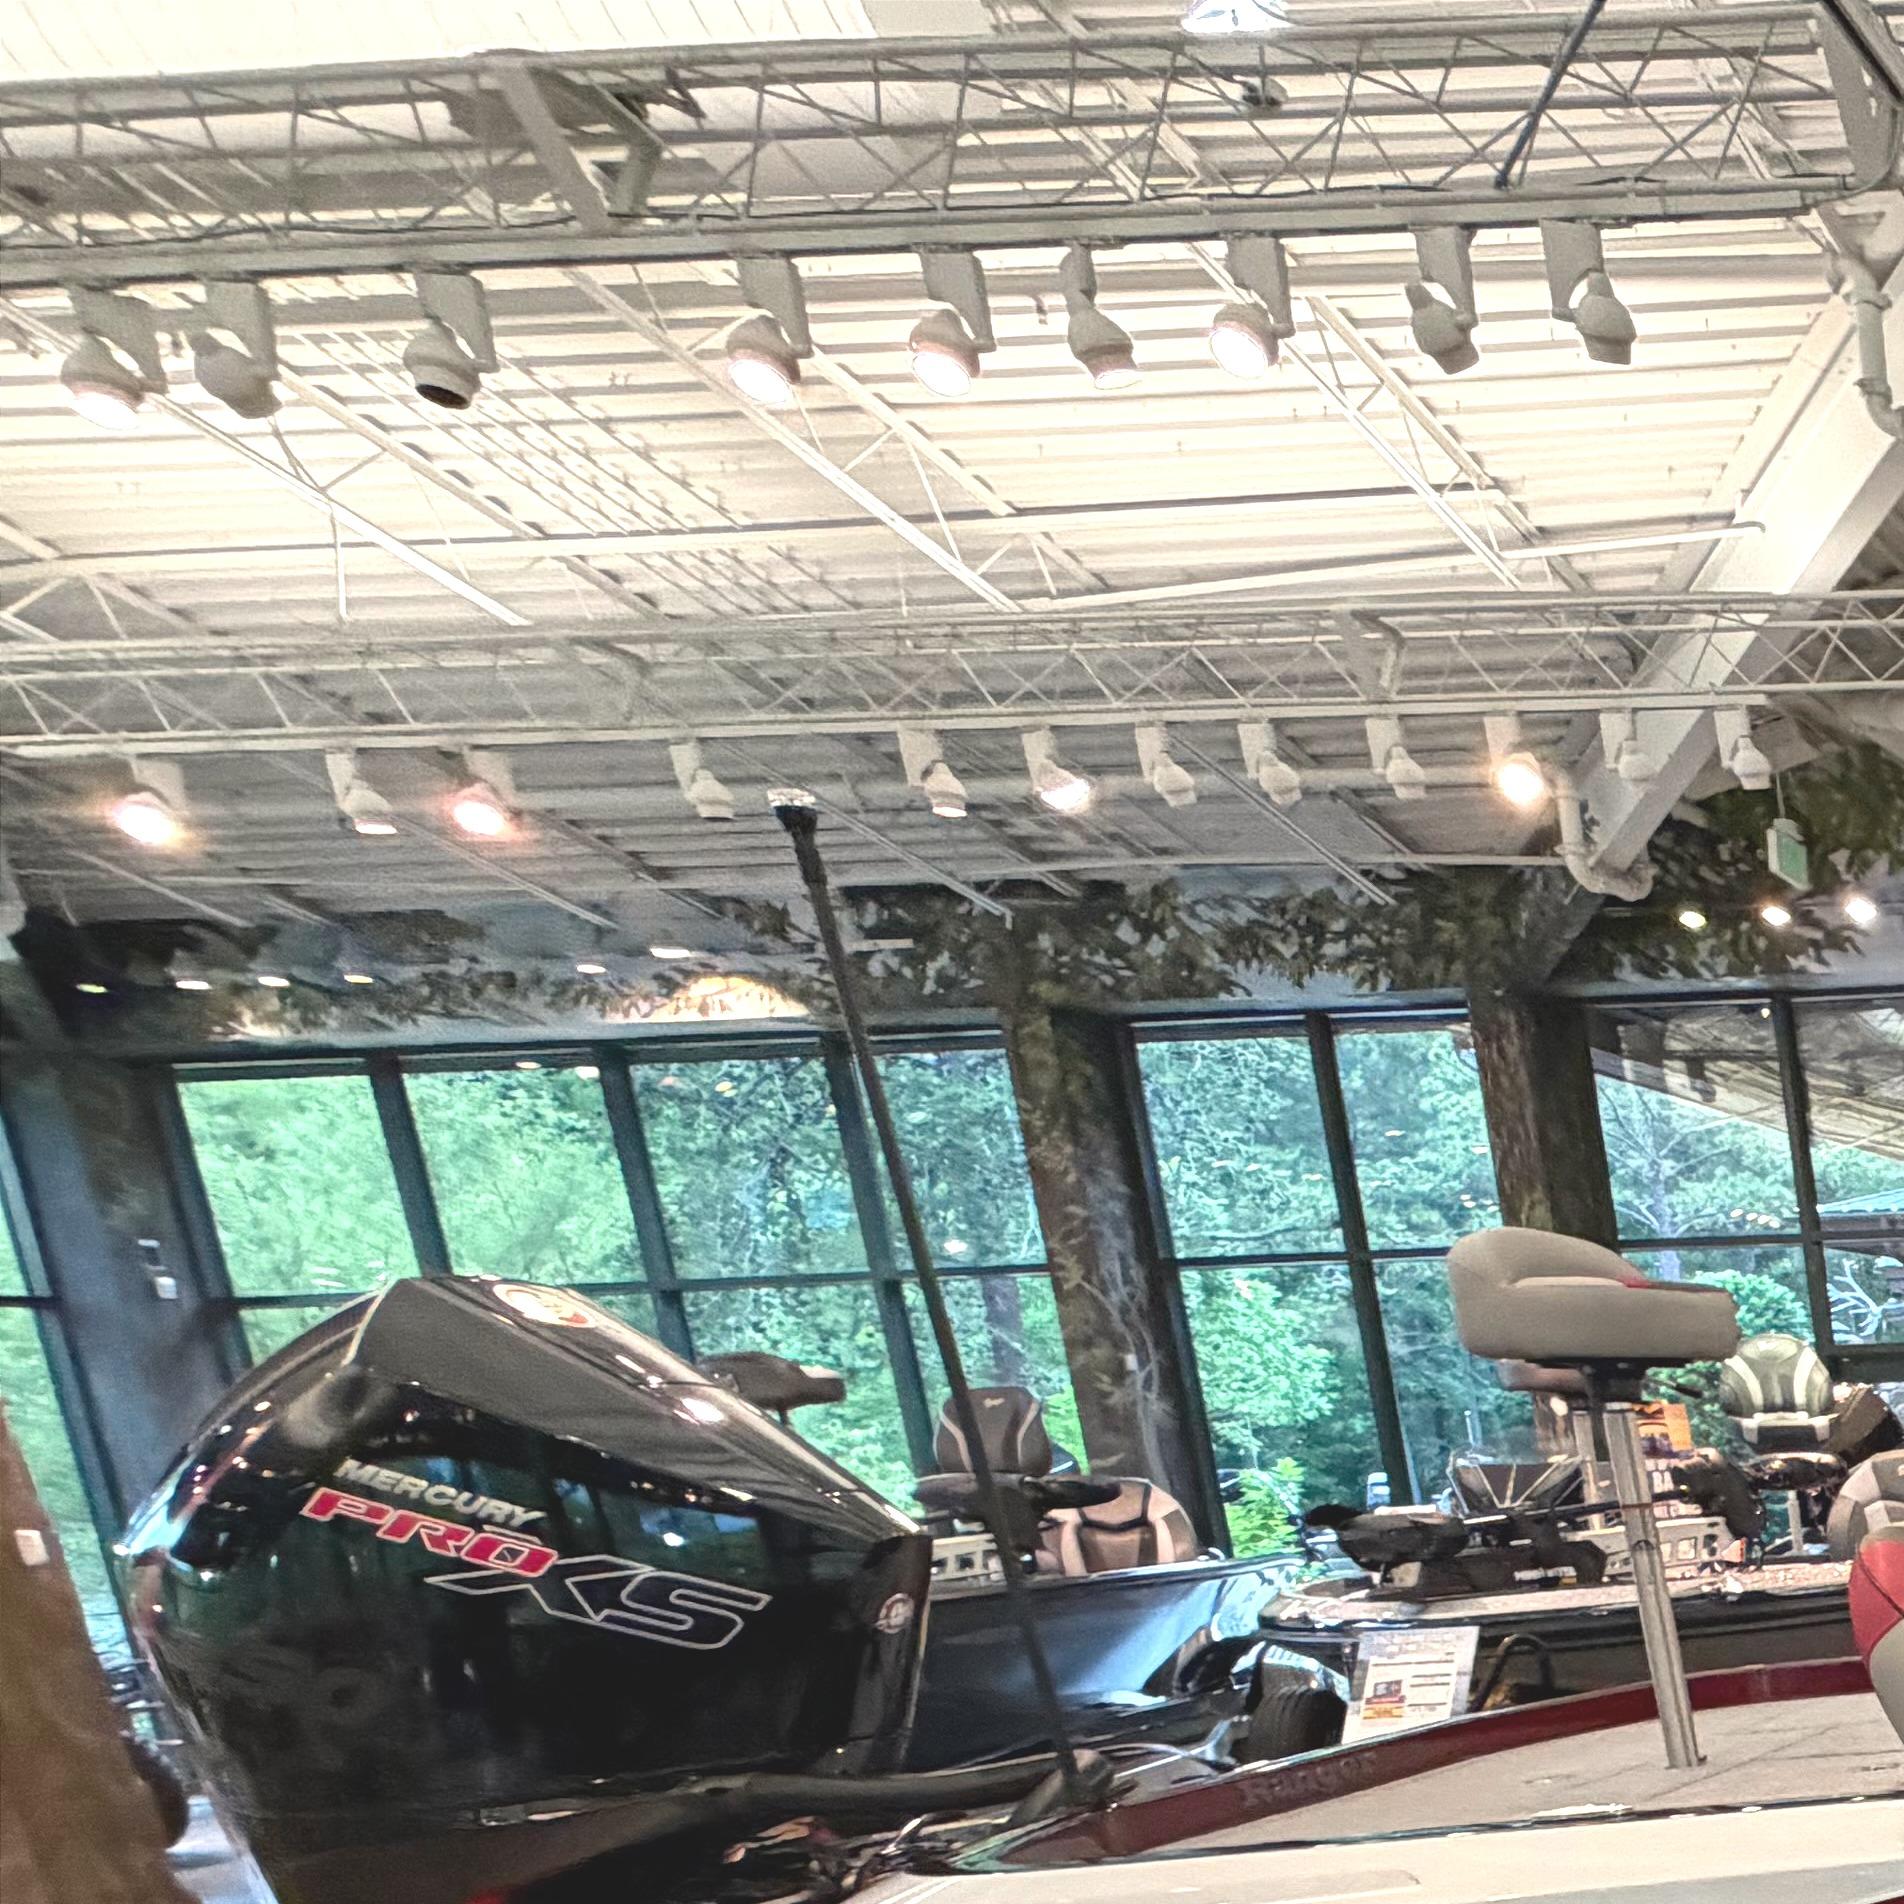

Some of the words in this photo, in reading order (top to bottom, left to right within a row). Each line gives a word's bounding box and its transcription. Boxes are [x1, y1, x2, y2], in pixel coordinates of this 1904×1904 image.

[299, 1486, 561, 1578] PRO
[332, 1456, 548, 1528] MERCURY
[423, 1553, 774, 1650] XS
